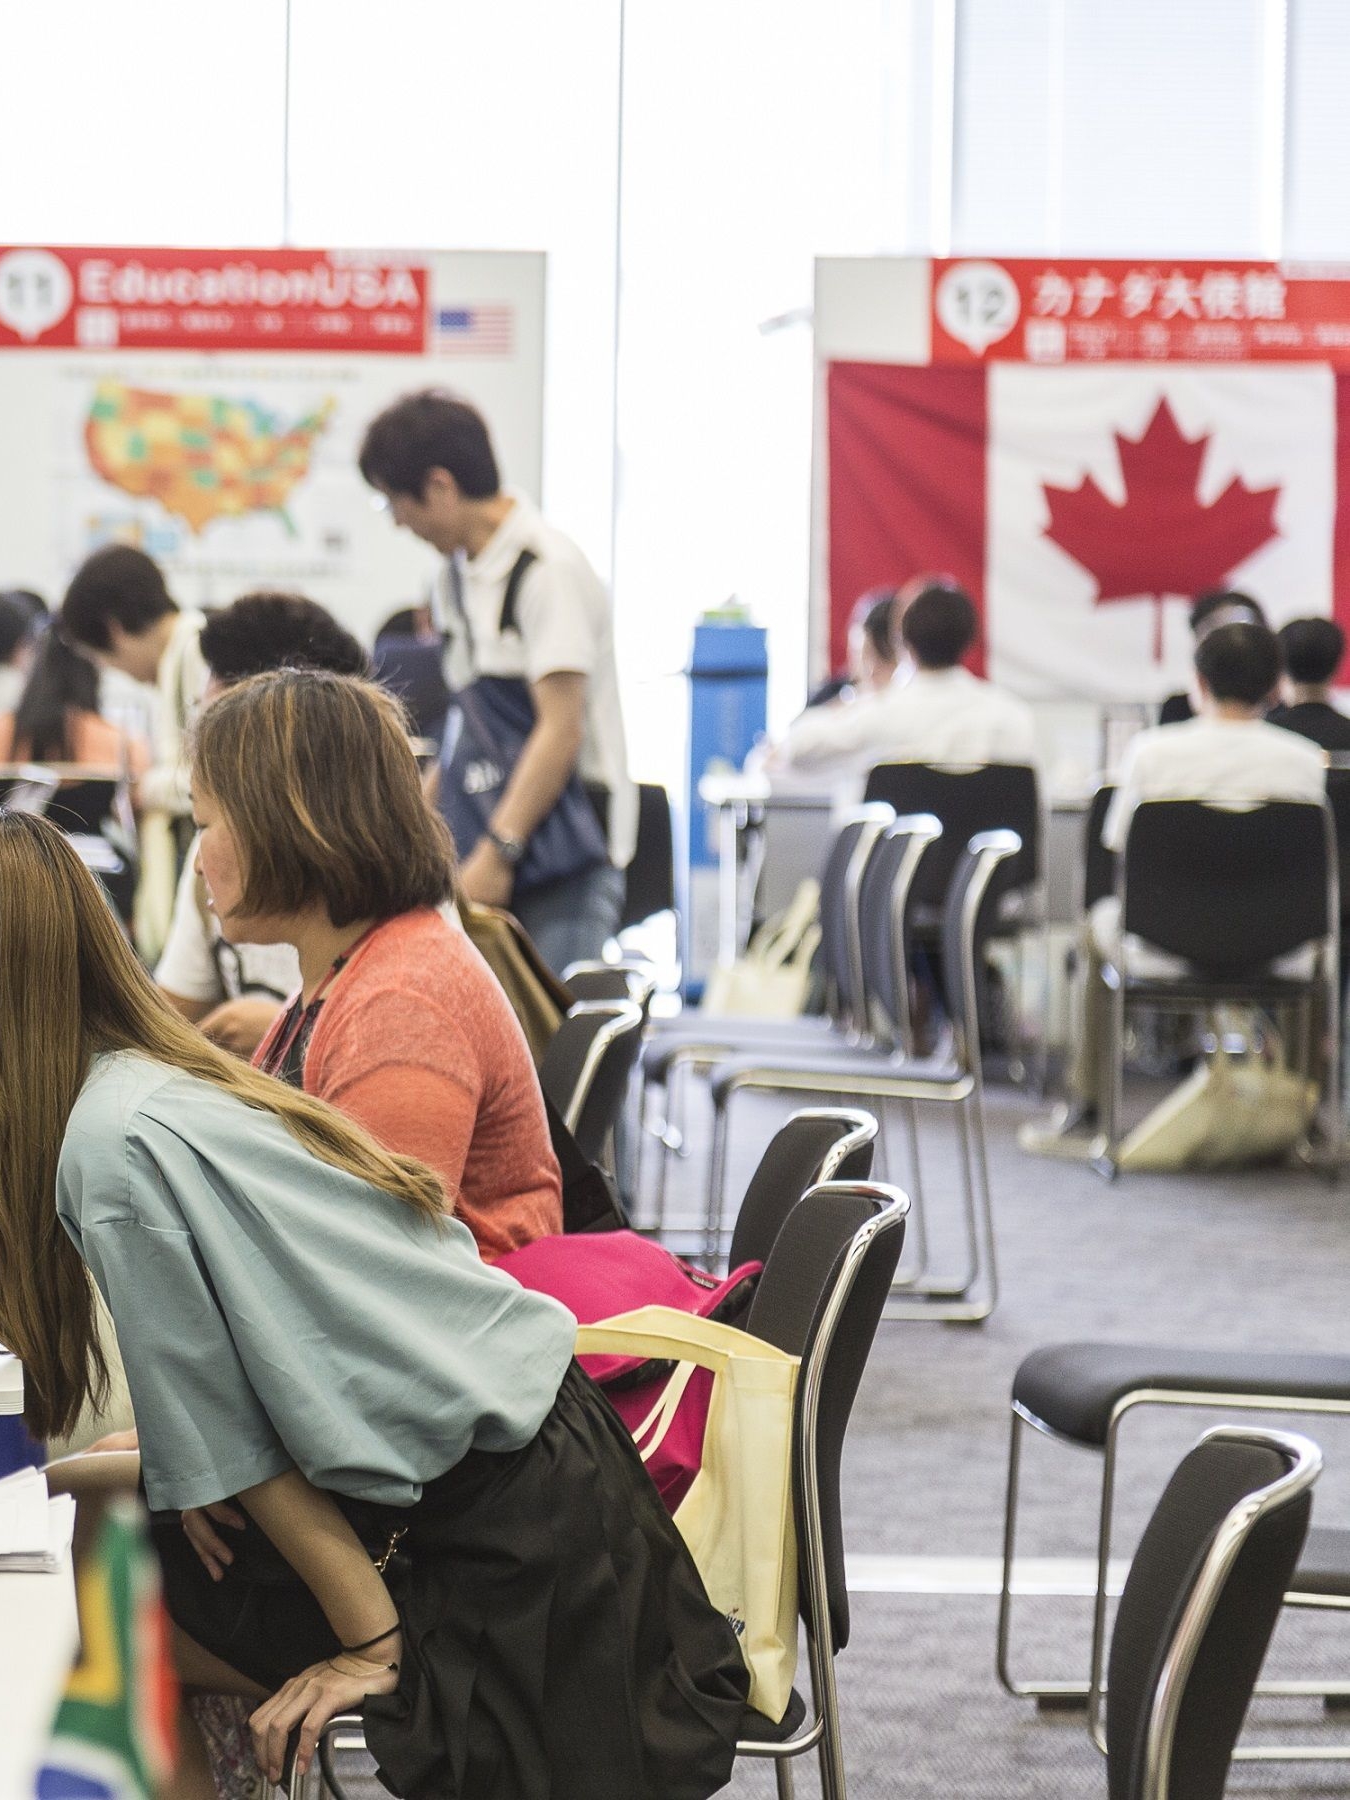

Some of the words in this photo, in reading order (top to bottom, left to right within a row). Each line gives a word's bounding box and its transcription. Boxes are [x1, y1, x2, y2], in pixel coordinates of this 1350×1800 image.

[81, 260, 420, 308] EducationUSA
[952, 275, 1006, 328] 12
[1033, 269, 1287, 319] カナダ大使館
